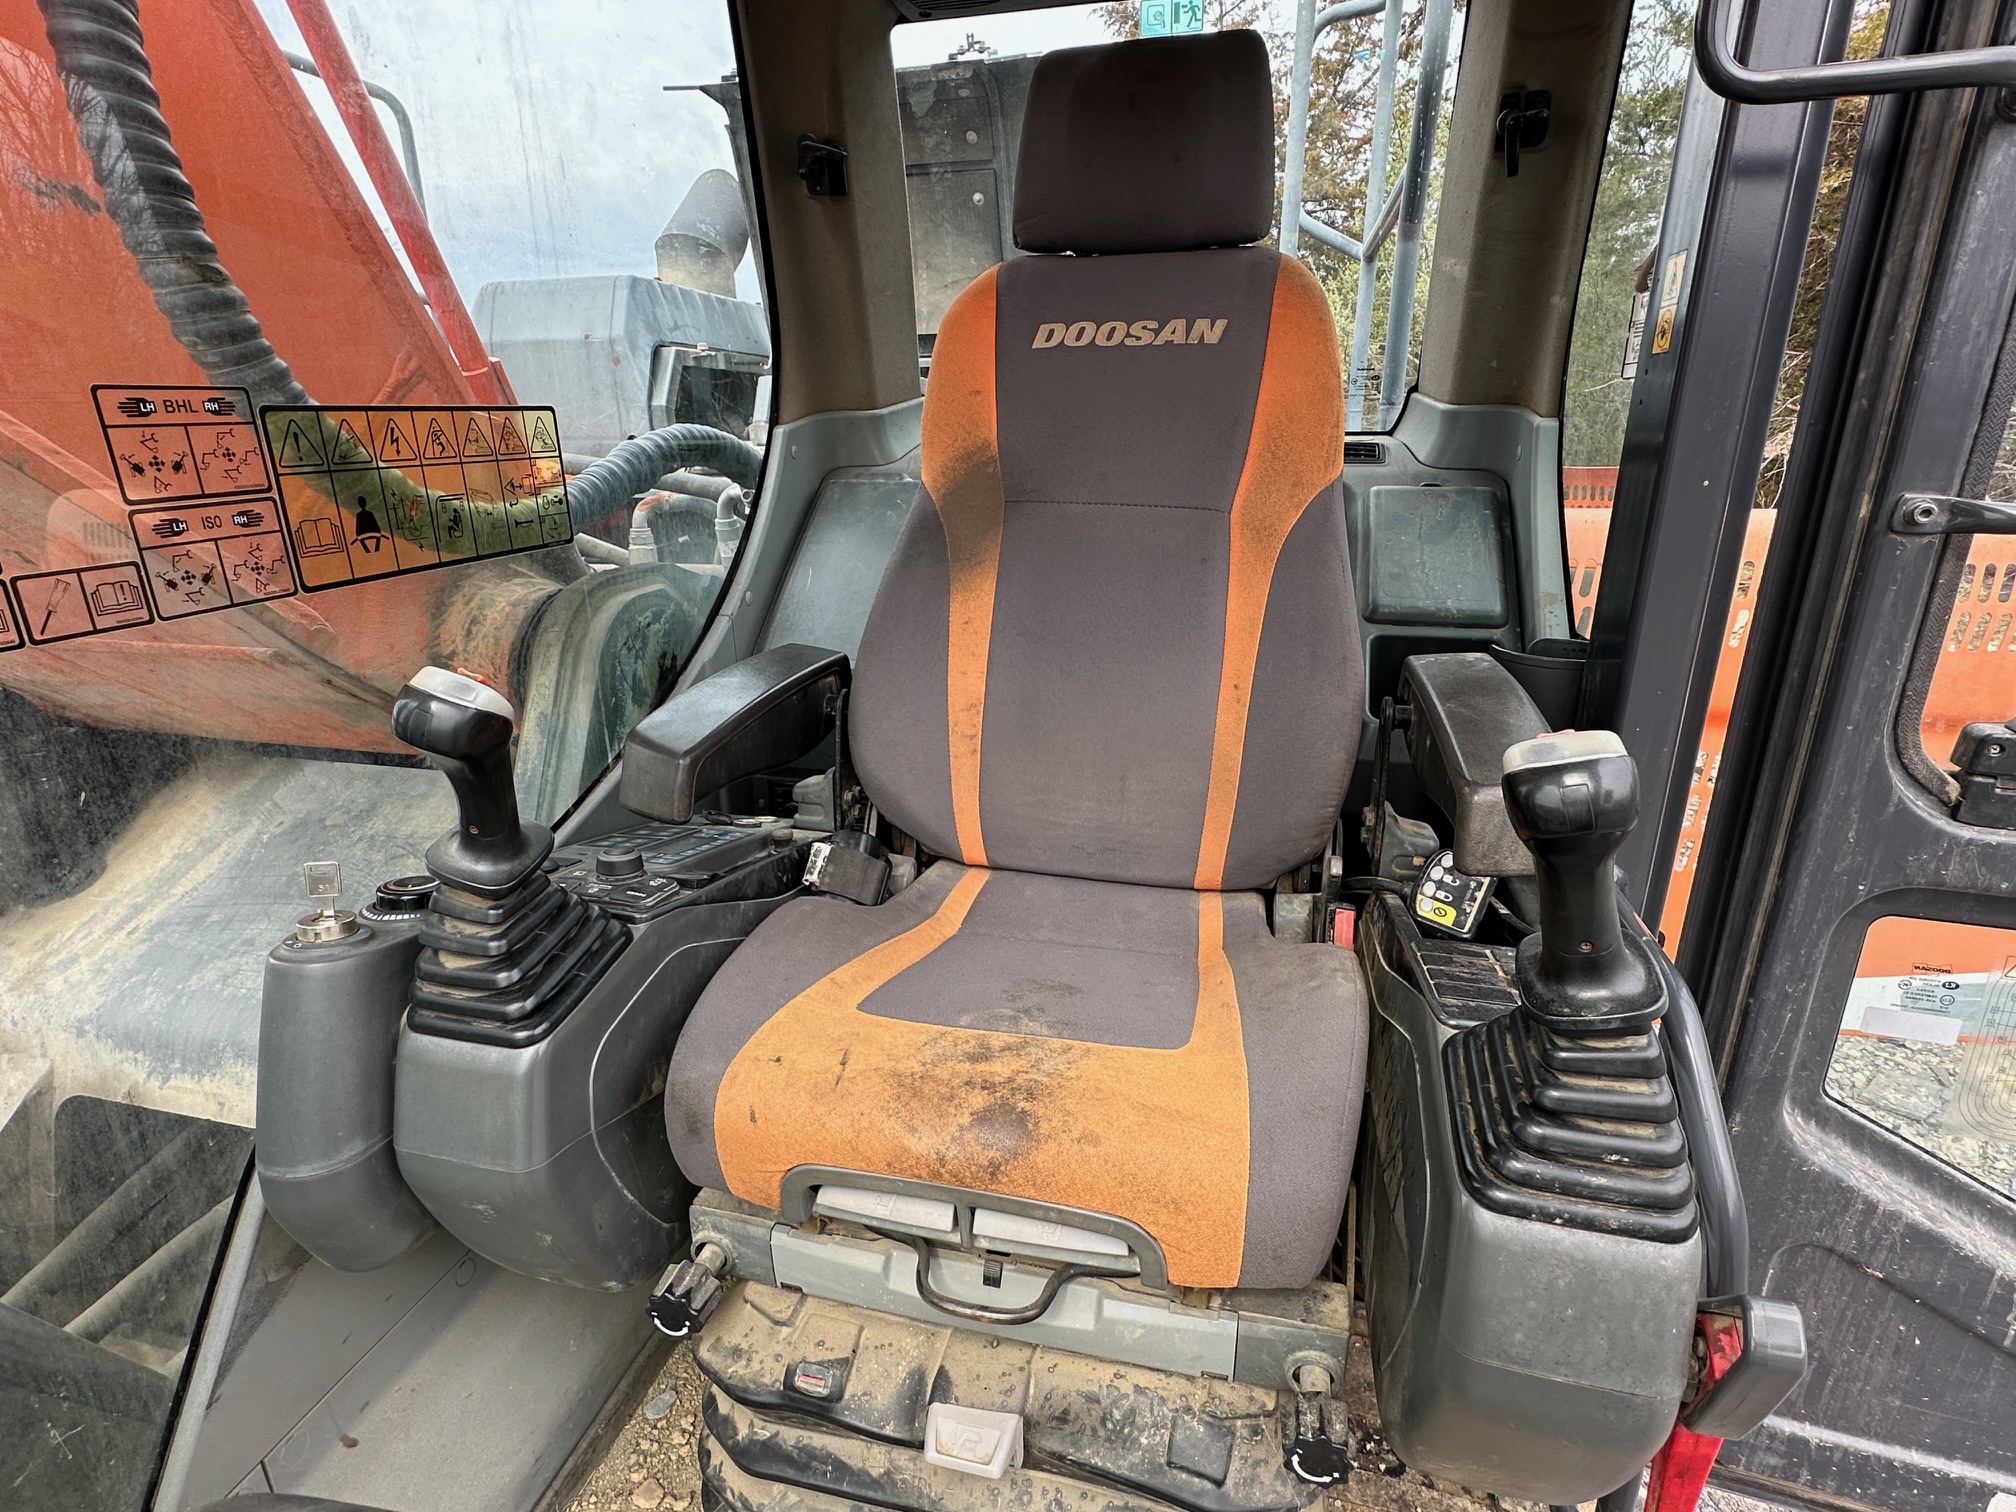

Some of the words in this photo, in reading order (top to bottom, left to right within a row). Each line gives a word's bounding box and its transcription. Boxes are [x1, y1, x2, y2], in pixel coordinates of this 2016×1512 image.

[1031, 318, 1229, 349] DOOSAN
[140, 402, 155, 412] LH
[162, 399, 200, 414] BHL
[204, 401, 219, 411] RH
[172, 522, 188, 531] LH
[201, 514, 223, 530] ISO
[233, 515, 248, 524] RH
